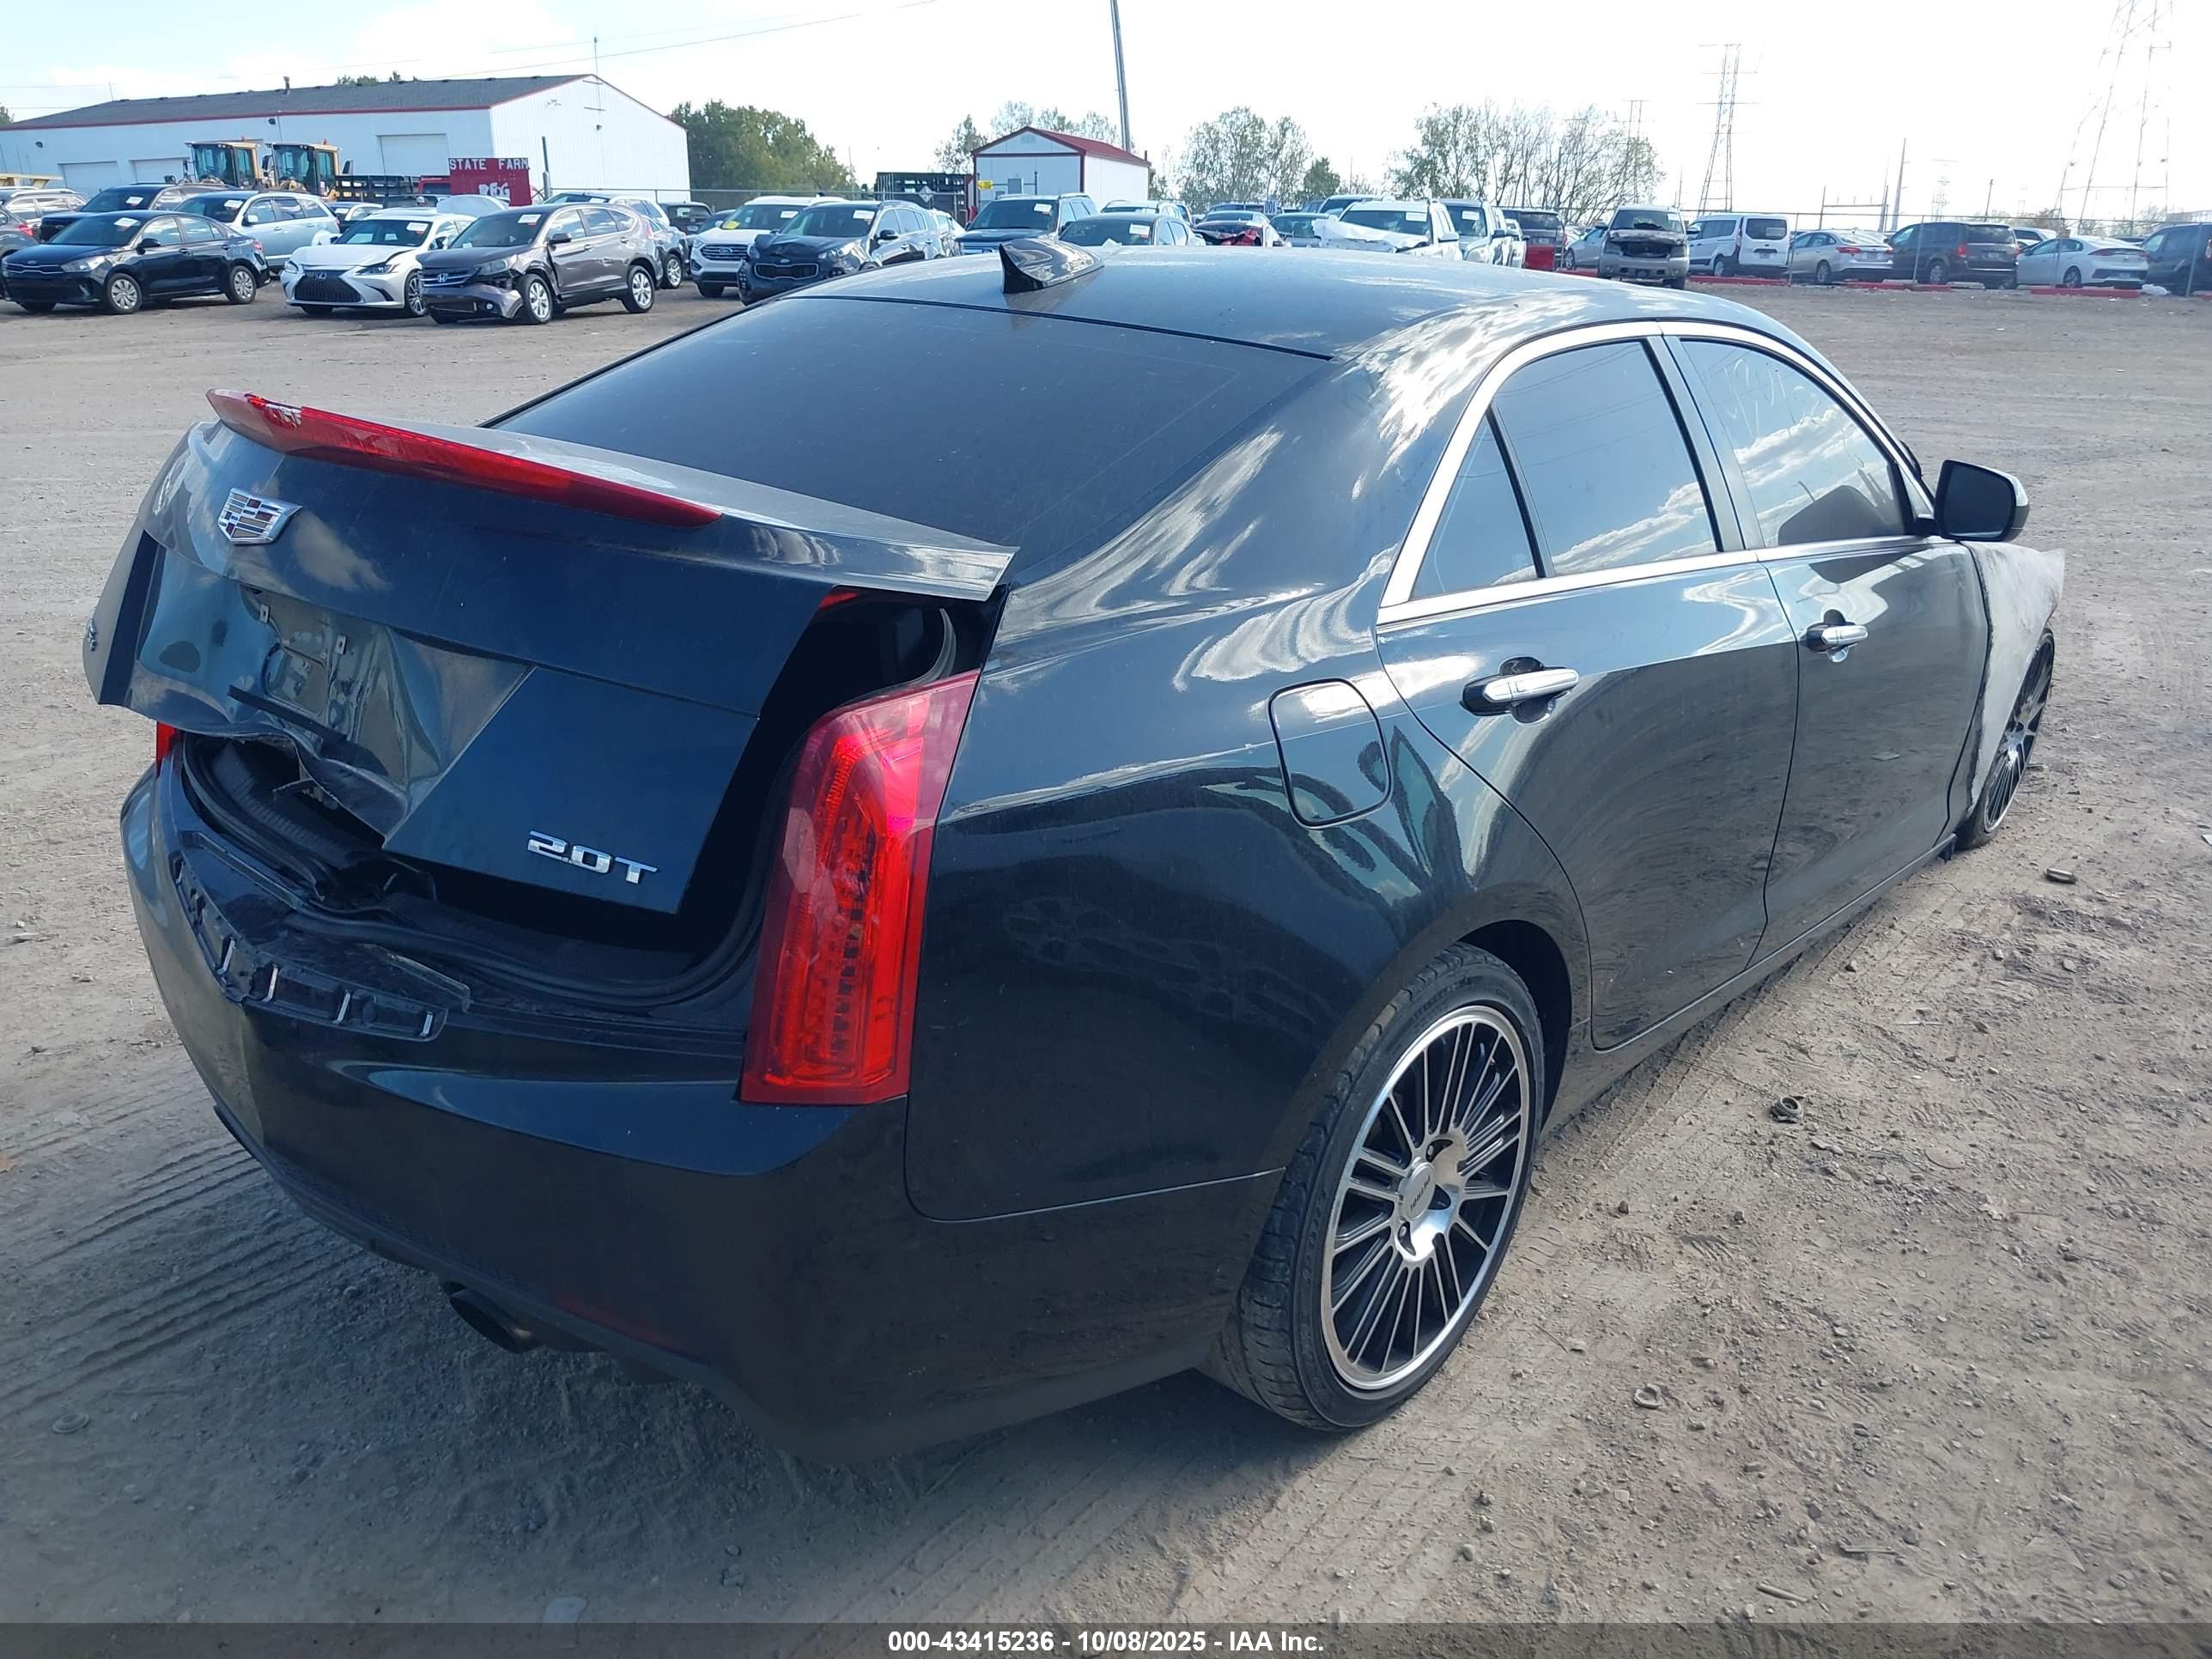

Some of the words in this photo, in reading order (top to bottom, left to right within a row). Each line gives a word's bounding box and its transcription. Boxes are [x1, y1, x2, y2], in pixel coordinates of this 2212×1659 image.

[449, 158, 487, 170] STATE
[498, 158, 528, 170] FARM
[527, 830, 659, 884] 2.0T
